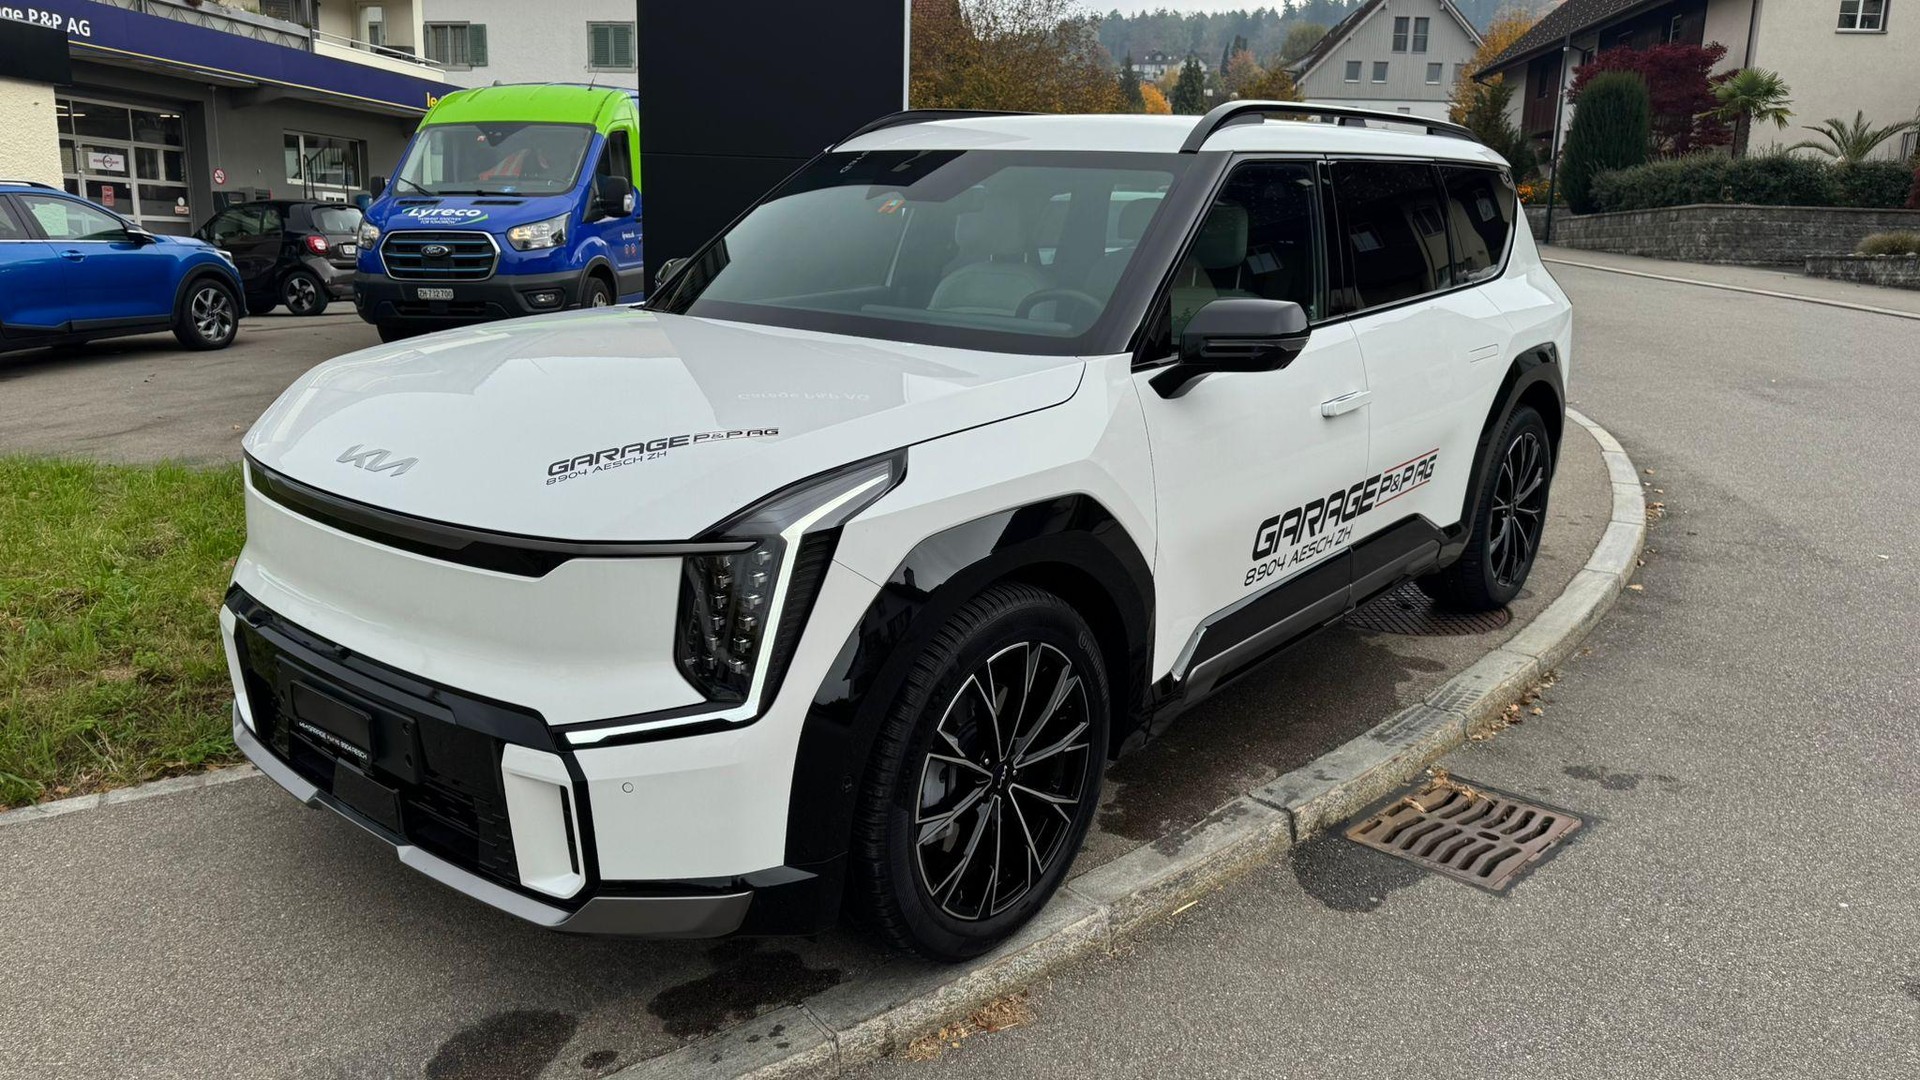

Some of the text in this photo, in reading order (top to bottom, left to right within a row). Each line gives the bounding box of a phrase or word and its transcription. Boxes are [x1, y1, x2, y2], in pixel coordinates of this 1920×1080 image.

[28, 8, 63, 30] P&P
[66, 17, 91, 37] AG
[408, 208, 482, 218] Lyreco
[546, 451, 667, 486] 8904 AESCH ZH
[548, 427, 779, 477] GARAGE P&P AG
[1252, 453, 1438, 561] GARAGE P&P AG
[1244, 523, 1354, 587] 8904 AESCH ZH
